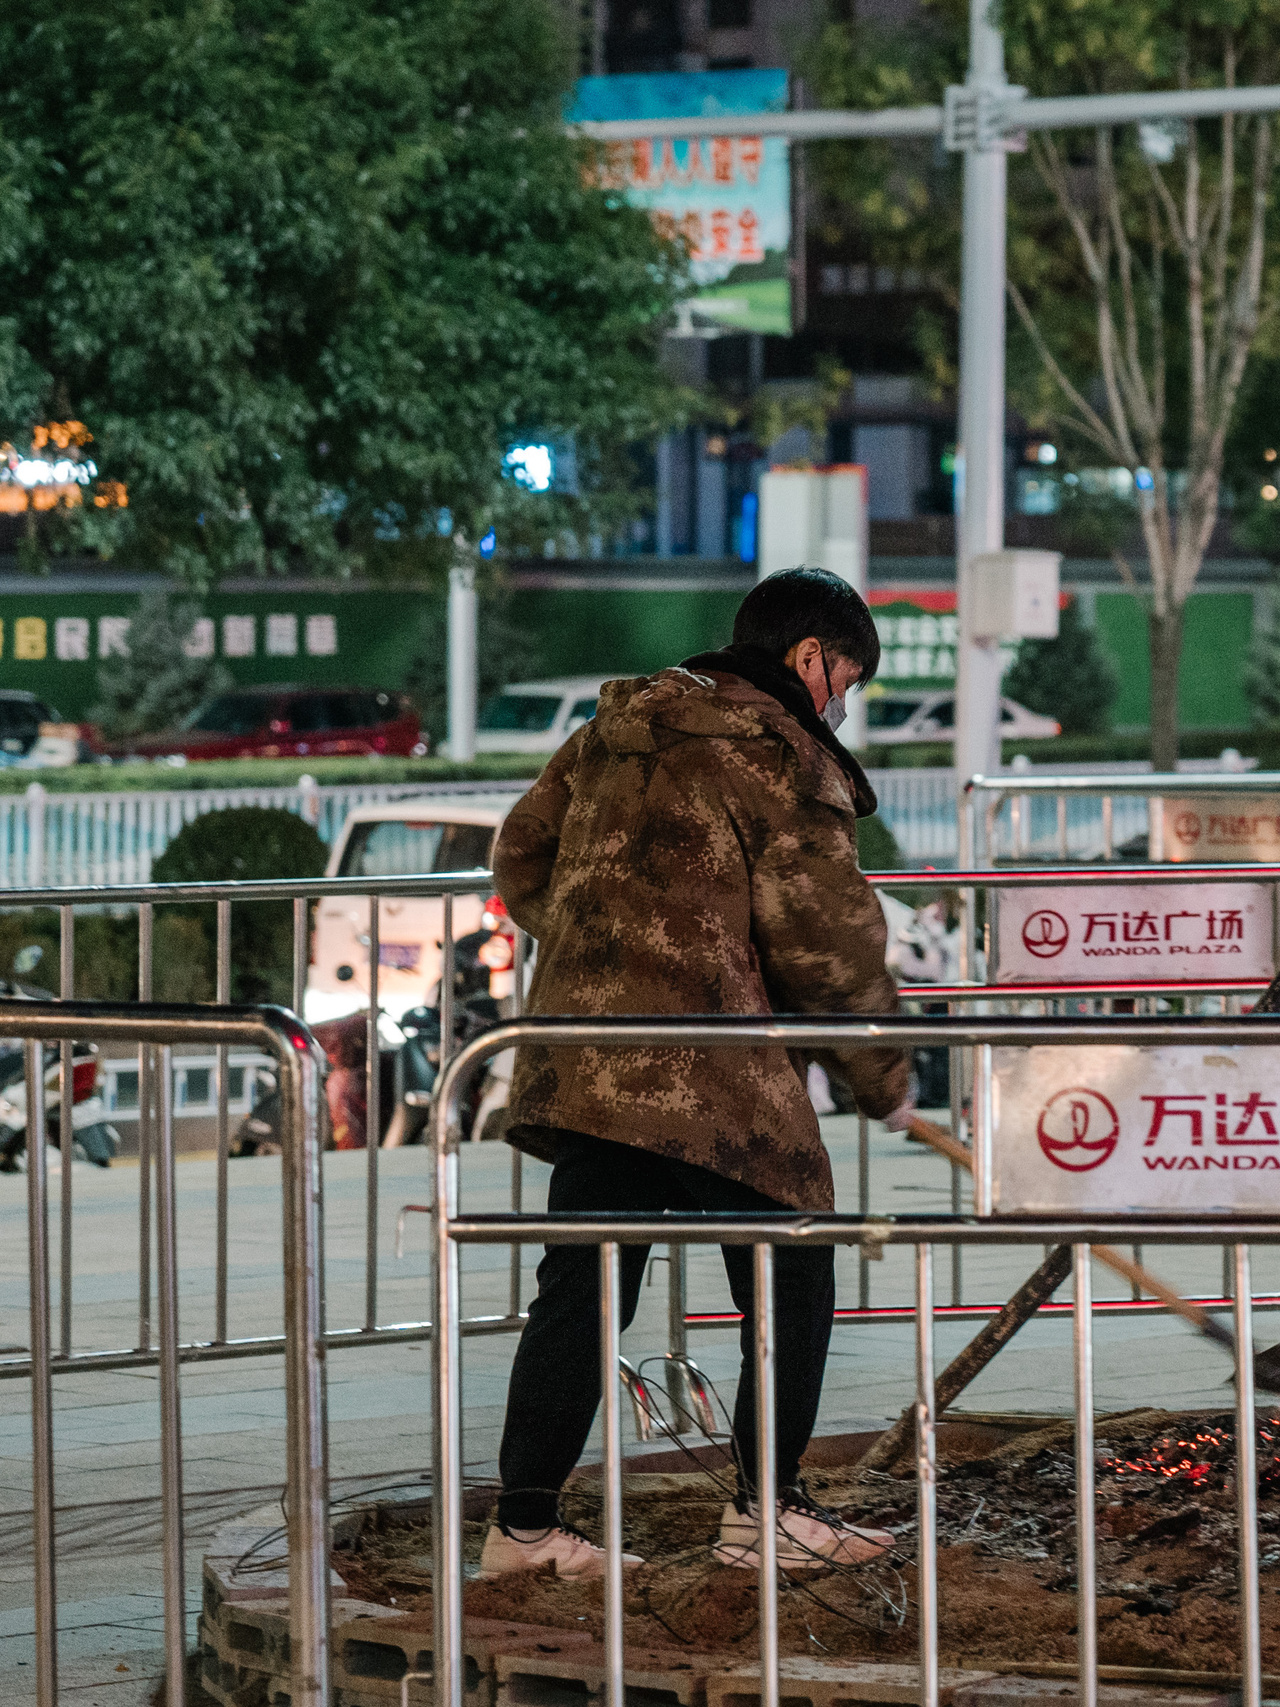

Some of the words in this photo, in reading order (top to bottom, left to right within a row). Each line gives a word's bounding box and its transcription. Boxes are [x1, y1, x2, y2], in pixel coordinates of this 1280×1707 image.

[1081, 910, 1244, 943] 万达广场
[1082, 945, 1161, 957] WANDA
[1169, 944, 1243, 955] PLAZA
